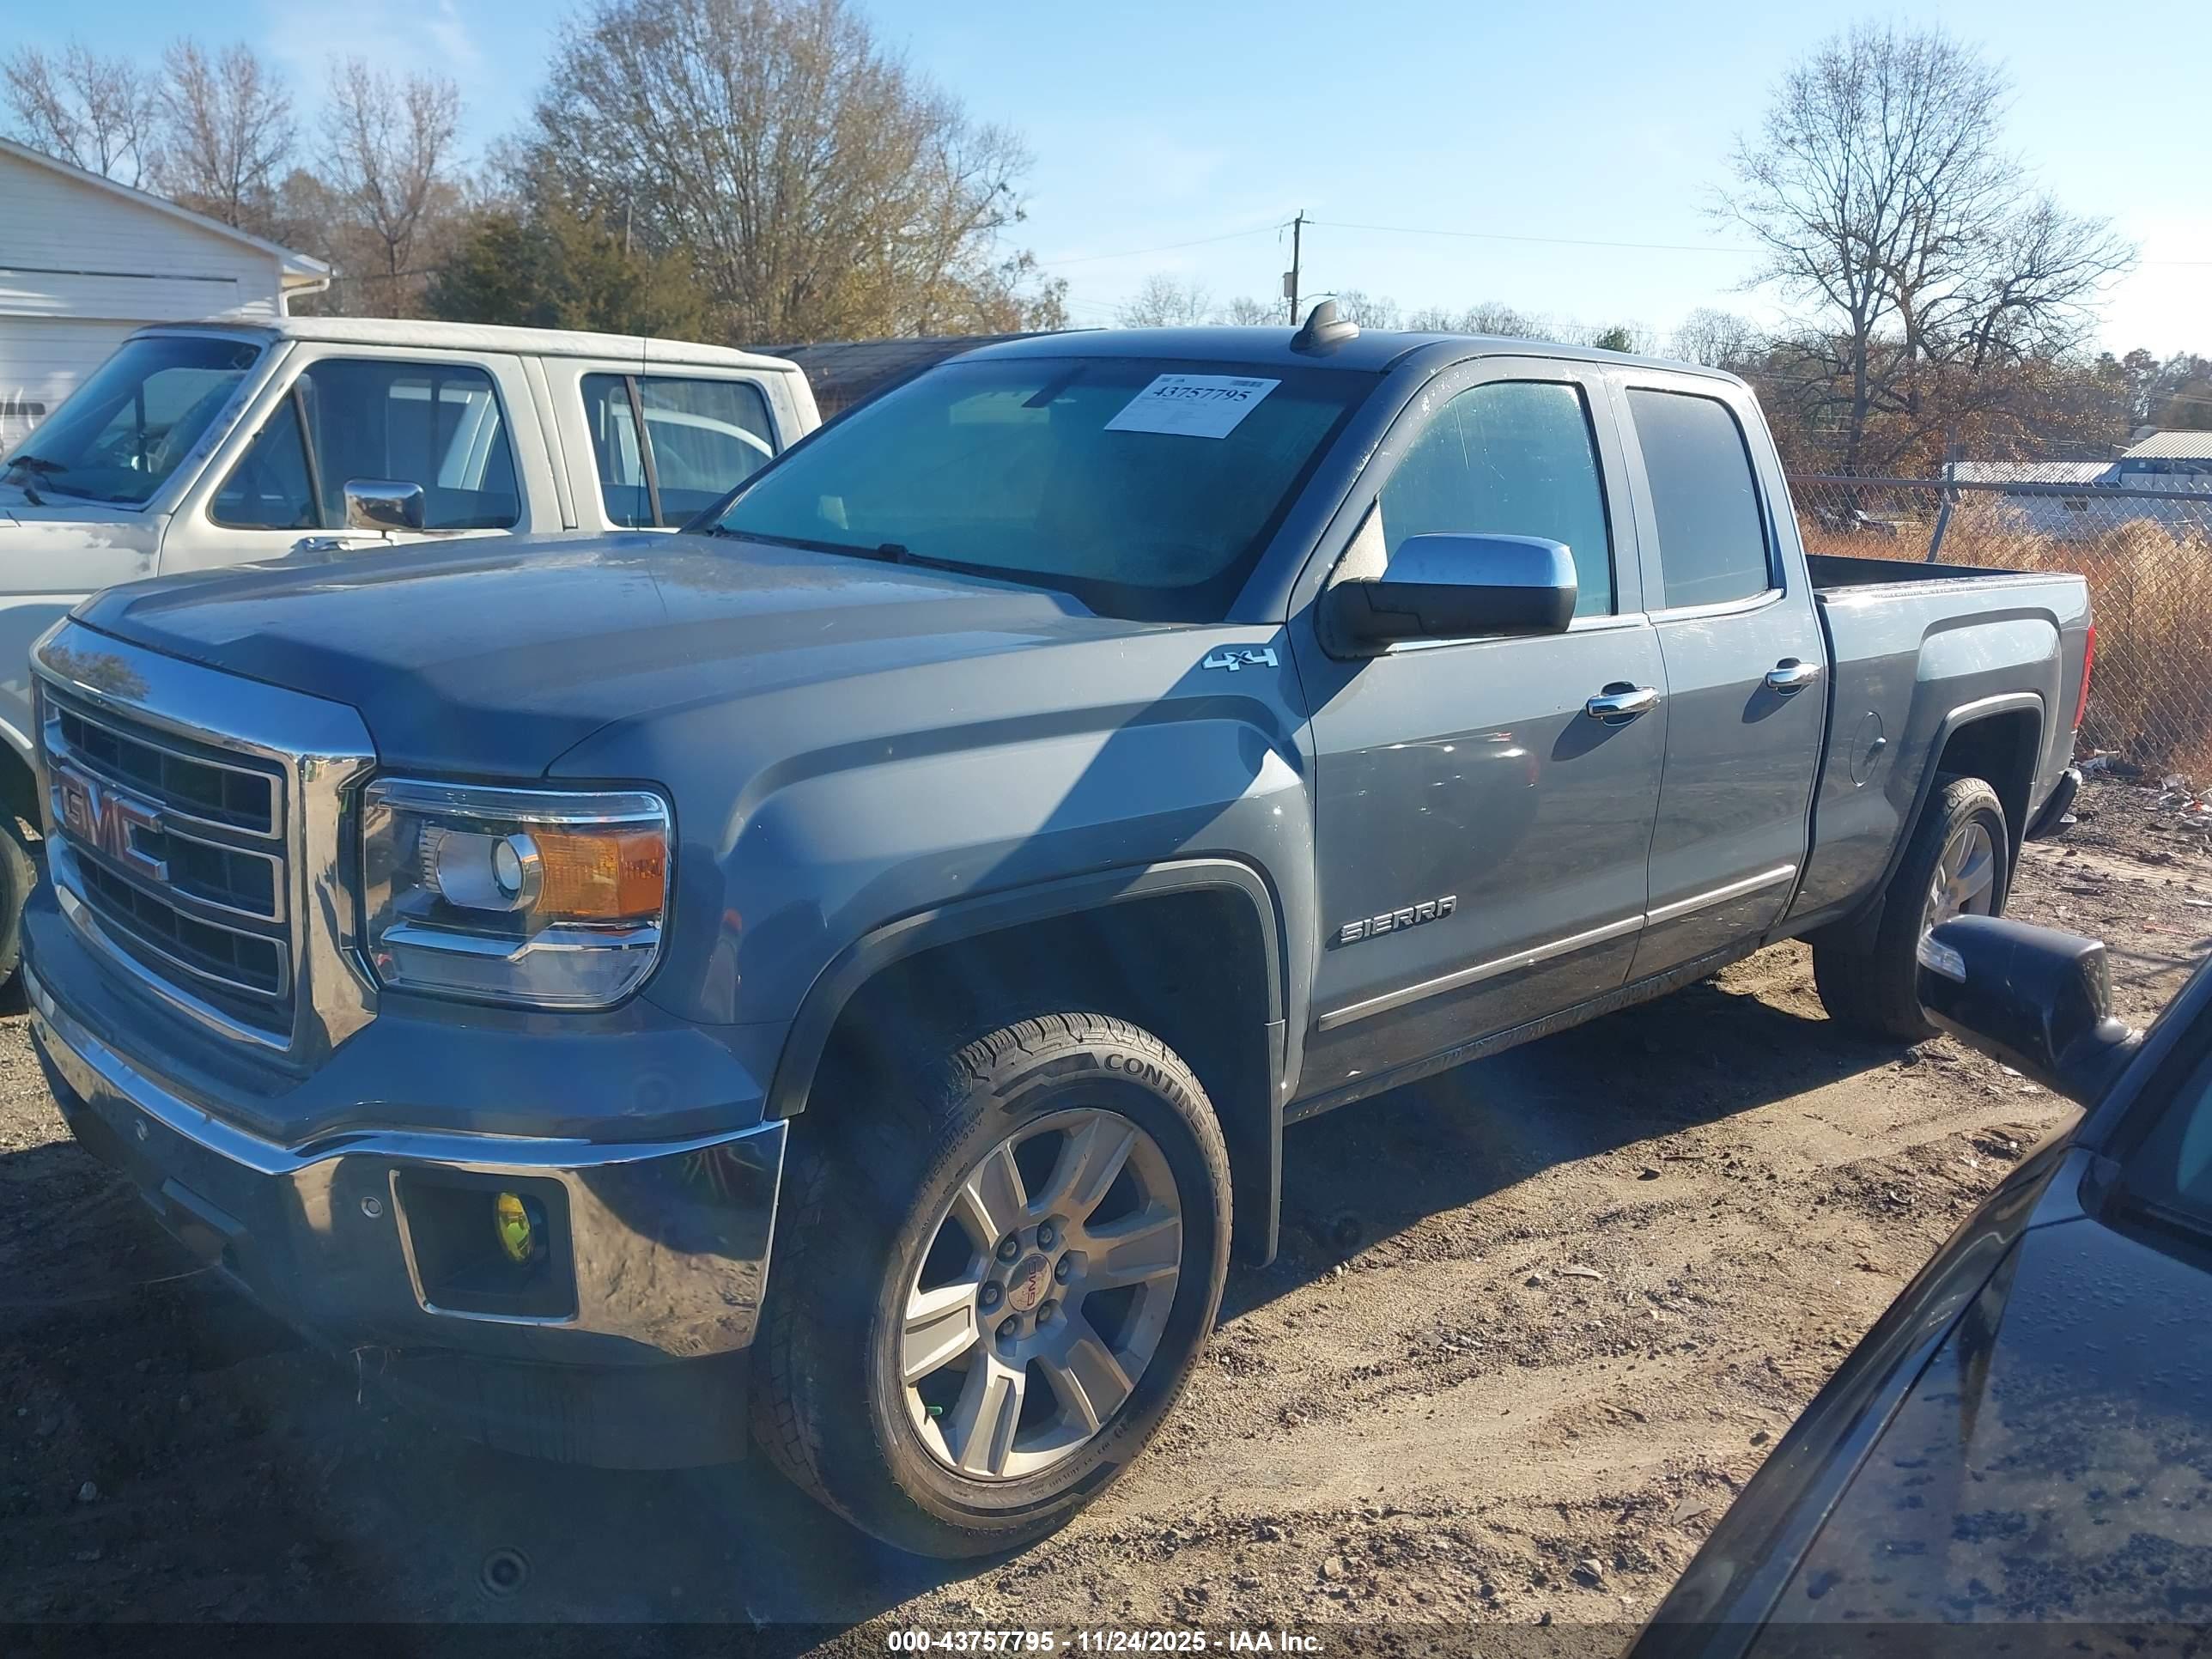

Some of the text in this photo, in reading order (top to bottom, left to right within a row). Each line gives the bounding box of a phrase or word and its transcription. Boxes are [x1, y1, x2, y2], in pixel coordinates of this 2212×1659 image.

[1153, 386, 1253, 402] 43757795
[50, 765, 168, 881] GMC
[1340, 895, 1457, 944] SIERRA
[1026, 1261, 1037, 1307] GMC
